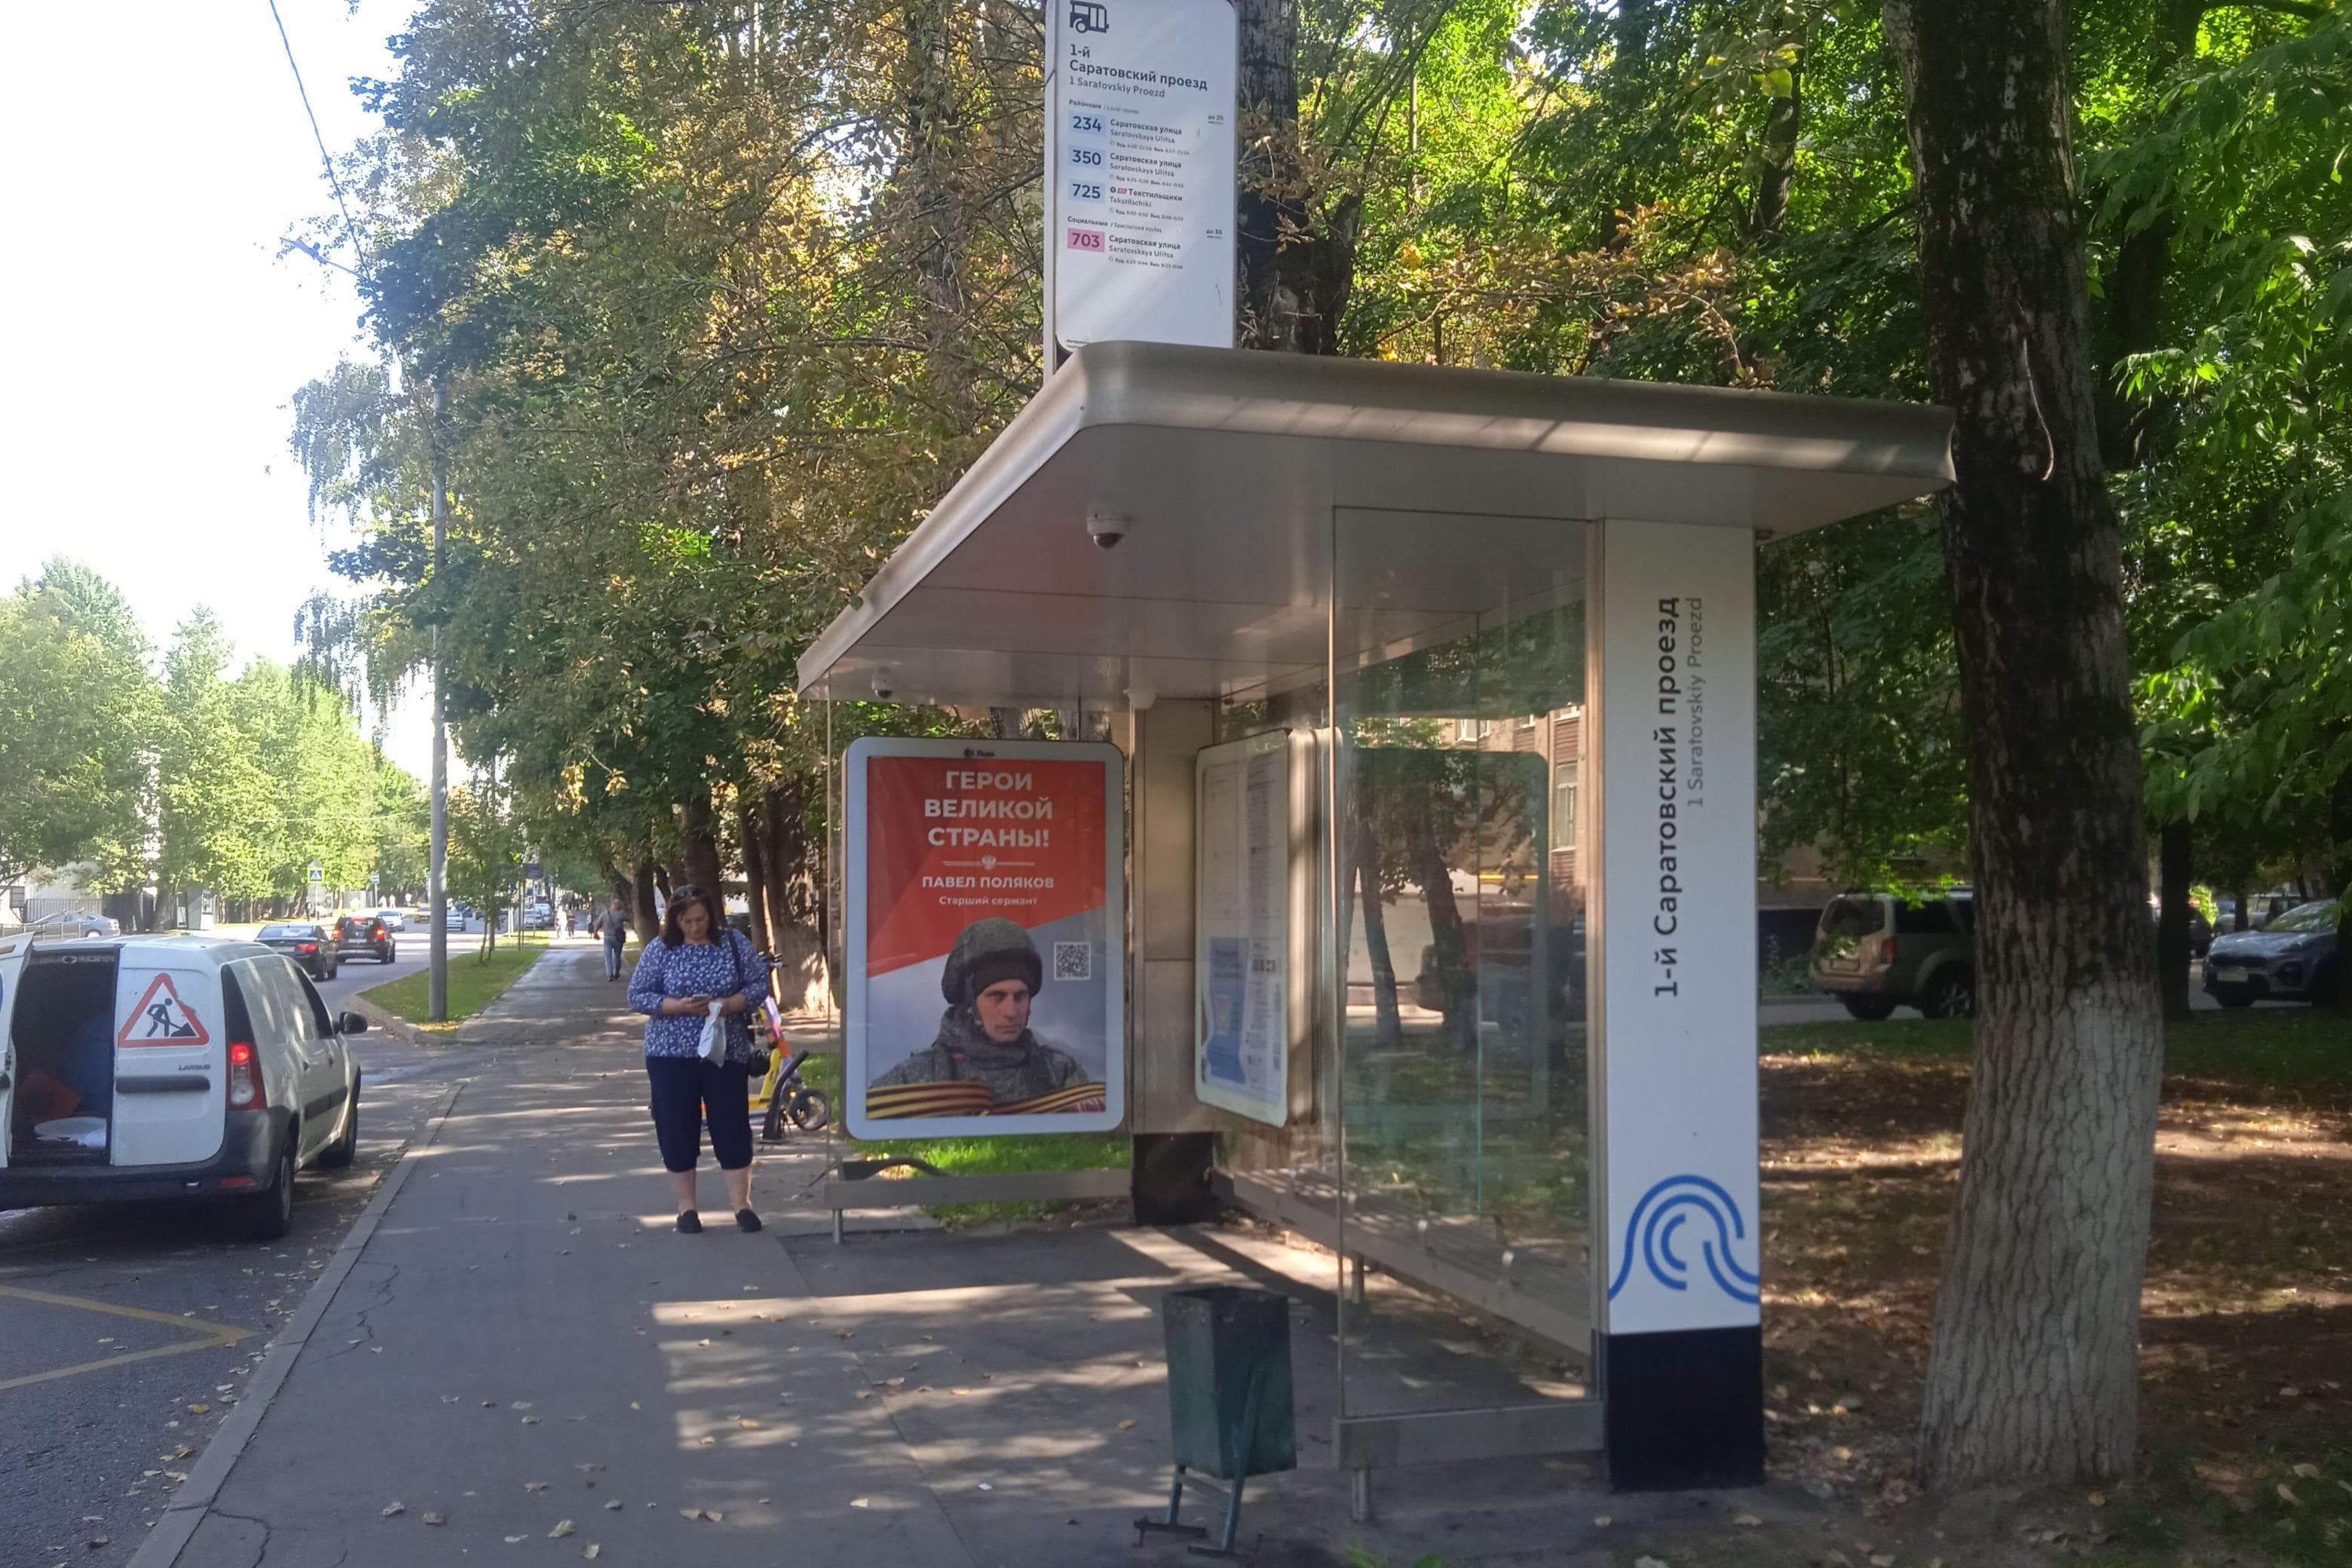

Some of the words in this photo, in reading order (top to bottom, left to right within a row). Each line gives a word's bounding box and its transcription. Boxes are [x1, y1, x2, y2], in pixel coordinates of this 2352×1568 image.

[1070, 44, 1090, 58] 1-й
[1070, 60, 1156, 83] Саратовский
[1160, 74, 1208, 91] проезд
[1069, 76, 1074, 85] 1
[1077, 78, 1131, 94] Saratovskiy
[1133, 86, 1165, 97] Proezd
[1073, 115, 1102, 132] 234
[1110, 118, 1158, 131] Саратовская
[1159, 126, 1182, 135] улица
[1110, 129, 1154, 141] Saratovskaya
[1072, 149, 1101, 166] 350
[1110, 152, 1158, 165] Саратовская
[1159, 161, 1181, 169] улица
[1110, 163, 1153, 175] Saratovskaya
[1155, 168, 1174, 176] Ulitsa
[1072, 183, 1101, 199] 725
[1128, 188, 1183, 201] Текстильщики
[1067, 216, 1108, 226] Социальные
[1071, 232, 1100, 248] 703
[1109, 234, 1157, 247] Саратовская
[1158, 241, 1181, 250] улица
[1109, 245, 1153, 256] Saratovskaya
[1686, 596, 1704, 667] Proezd
[1658, 596, 1682, 715] проезд
[1686, 672, 1707, 791] Saratovskiy
[945, 770, 1033, 792] ГЕРОИ
[924, 796, 1053, 820] ВЕЛИКОЙ
[1688, 796, 1704, 809] 1
[927, 826, 1049, 847] СТРАНЫ!
[1653, 725, 1683, 936] Саратовский
[921, 876, 975, 889] ПАВЕЛ
[980, 876, 1055, 890] ПОЛЯКОВ
[939, 895, 989, 907] Старший
[991, 896, 1038, 907] сержант
[1654, 947, 1678, 997] 1-й
